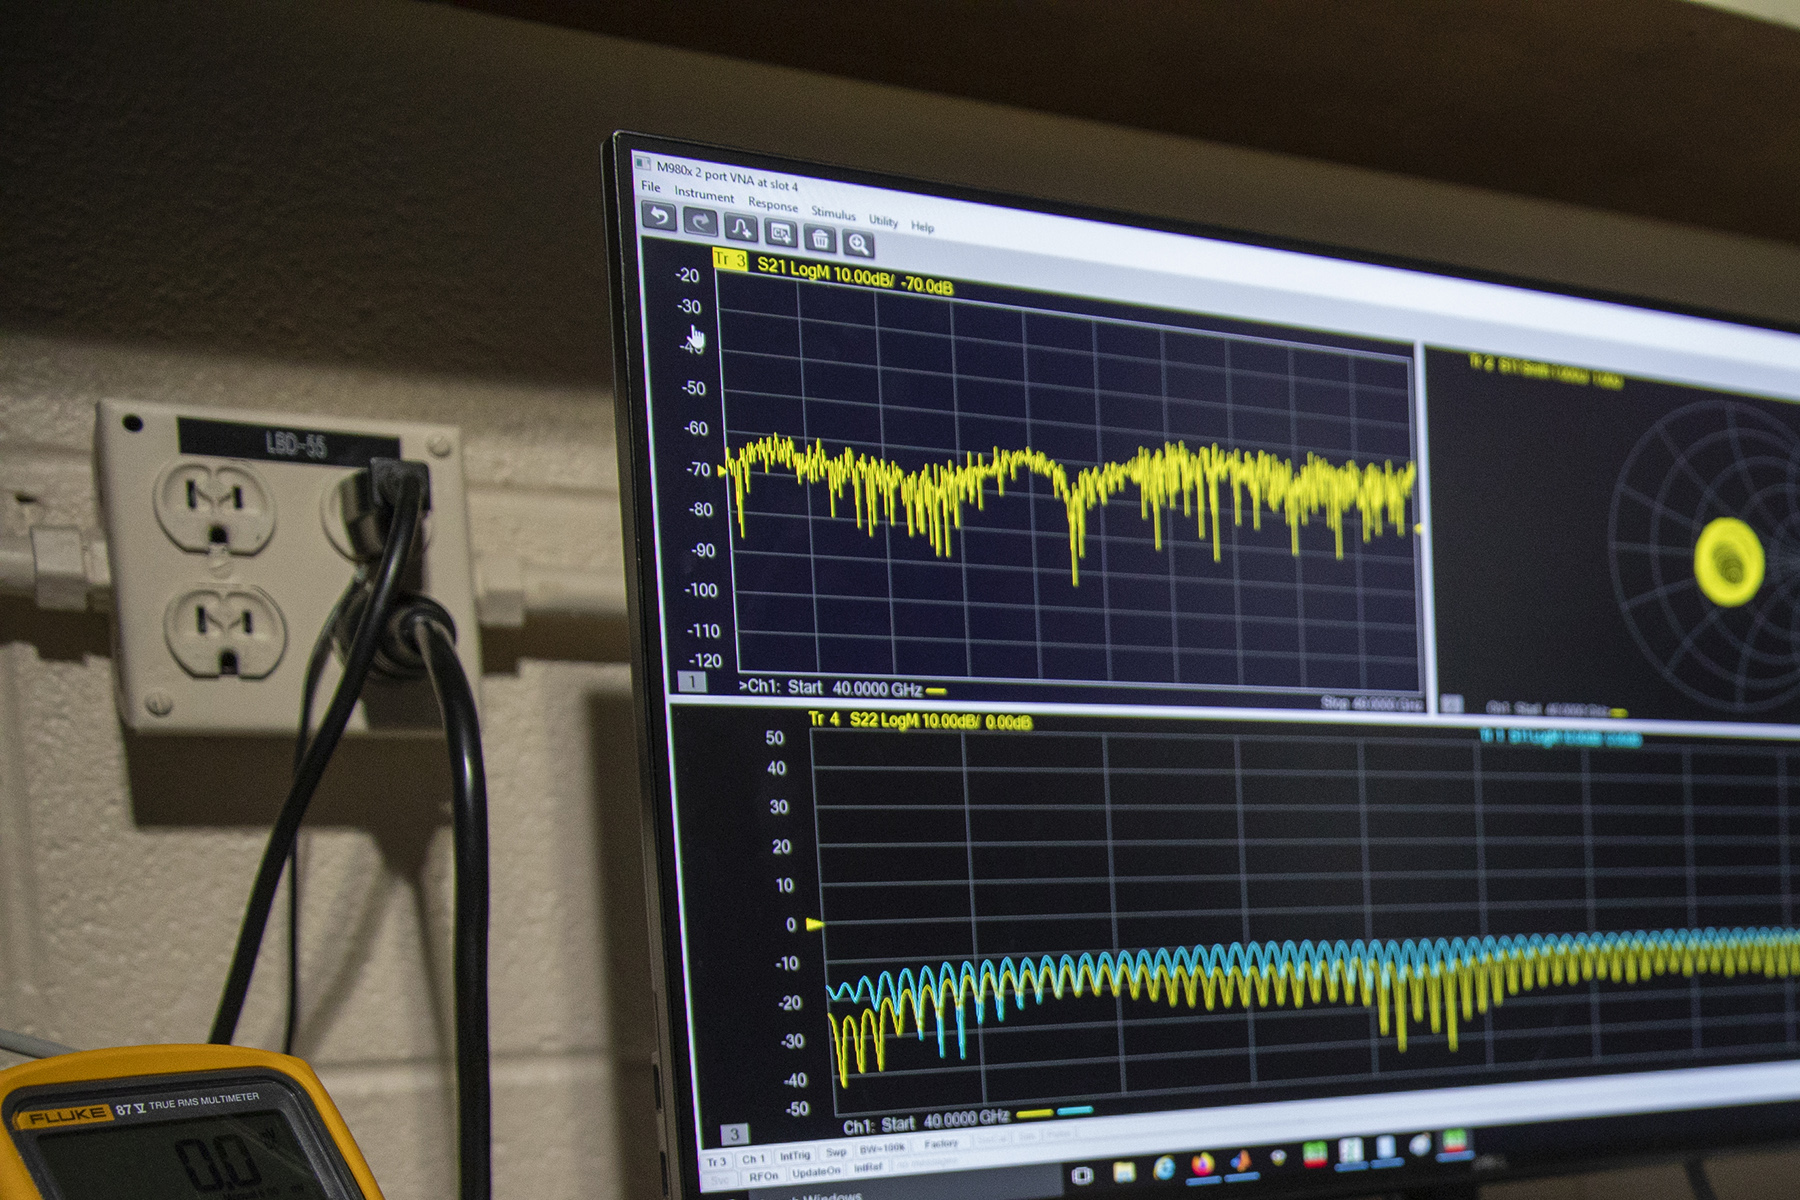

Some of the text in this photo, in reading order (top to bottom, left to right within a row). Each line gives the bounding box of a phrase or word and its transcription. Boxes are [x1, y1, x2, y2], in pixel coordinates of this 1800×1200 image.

[657, 161, 798, 192] M980x 2 port VNA at slot 4
[641, 180, 935, 234] File Instrument Response Stimulus Utility Help
[675, 268, 700, 283] -20
[714, 251, 954, 297] Tr 3 S21 LogM 10.00dB/ -70.0dB
[677, 299, 701, 314] -30
[681, 380, 706, 396] -50
[684, 421, 709, 436] -60
[686, 462, 711, 478] -70
[689, 502, 714, 517] -80
[691, 542, 716, 558] -90
[684, 582, 718, 598] -100
[687, 623, 721, 639] -110
[689, 653, 723, 669] -120
[788, 680, 823, 696] Start
[832, 680, 888, 697] 40.0000
[891, 682, 924, 698] GHz
[808, 710, 825, 726] Tr
[829, 711, 841, 726] 4
[849, 711, 879, 728] S22
[881, 713, 921, 733] LogM
[985, 714, 1034, 732] 0.00dB
[765, 730, 786, 746] 50
[767, 760, 788, 776] 40
[769, 799, 790, 815] 30
[772, 839, 793, 855] 20
[776, 877, 795, 894] 10
[785, 917, 798, 933] 0
[775, 956, 800, 971] -10
[778, 995, 803, 1011] -20
[781, 1033, 806, 1049] -30
[783, 1072, 809, 1088] -40
[115, 1104, 133, 1116] 87
[149, 1099, 176, 1111] TRUE
[178, 1097, 199, 1107] RMS
[201, 1092, 260, 1105] MULTIMETER
[785, 1101, 811, 1117] -50
[29, 1107, 108, 1125] FLUKE
[843, 1108, 1011, 1136] Ch1: Start 40.0000 GHz
[730, 1128, 740, 1141] 3
[742, 1153, 757, 1165] Ch
[780, 1149, 811, 1162] IntTrig
[826, 1147, 847, 1159] Swp
[707, 1156, 727, 1168] Tr 3
[750, 1171, 779, 1183] RFOn
[792, 1166, 842, 1179] UpdateOn
